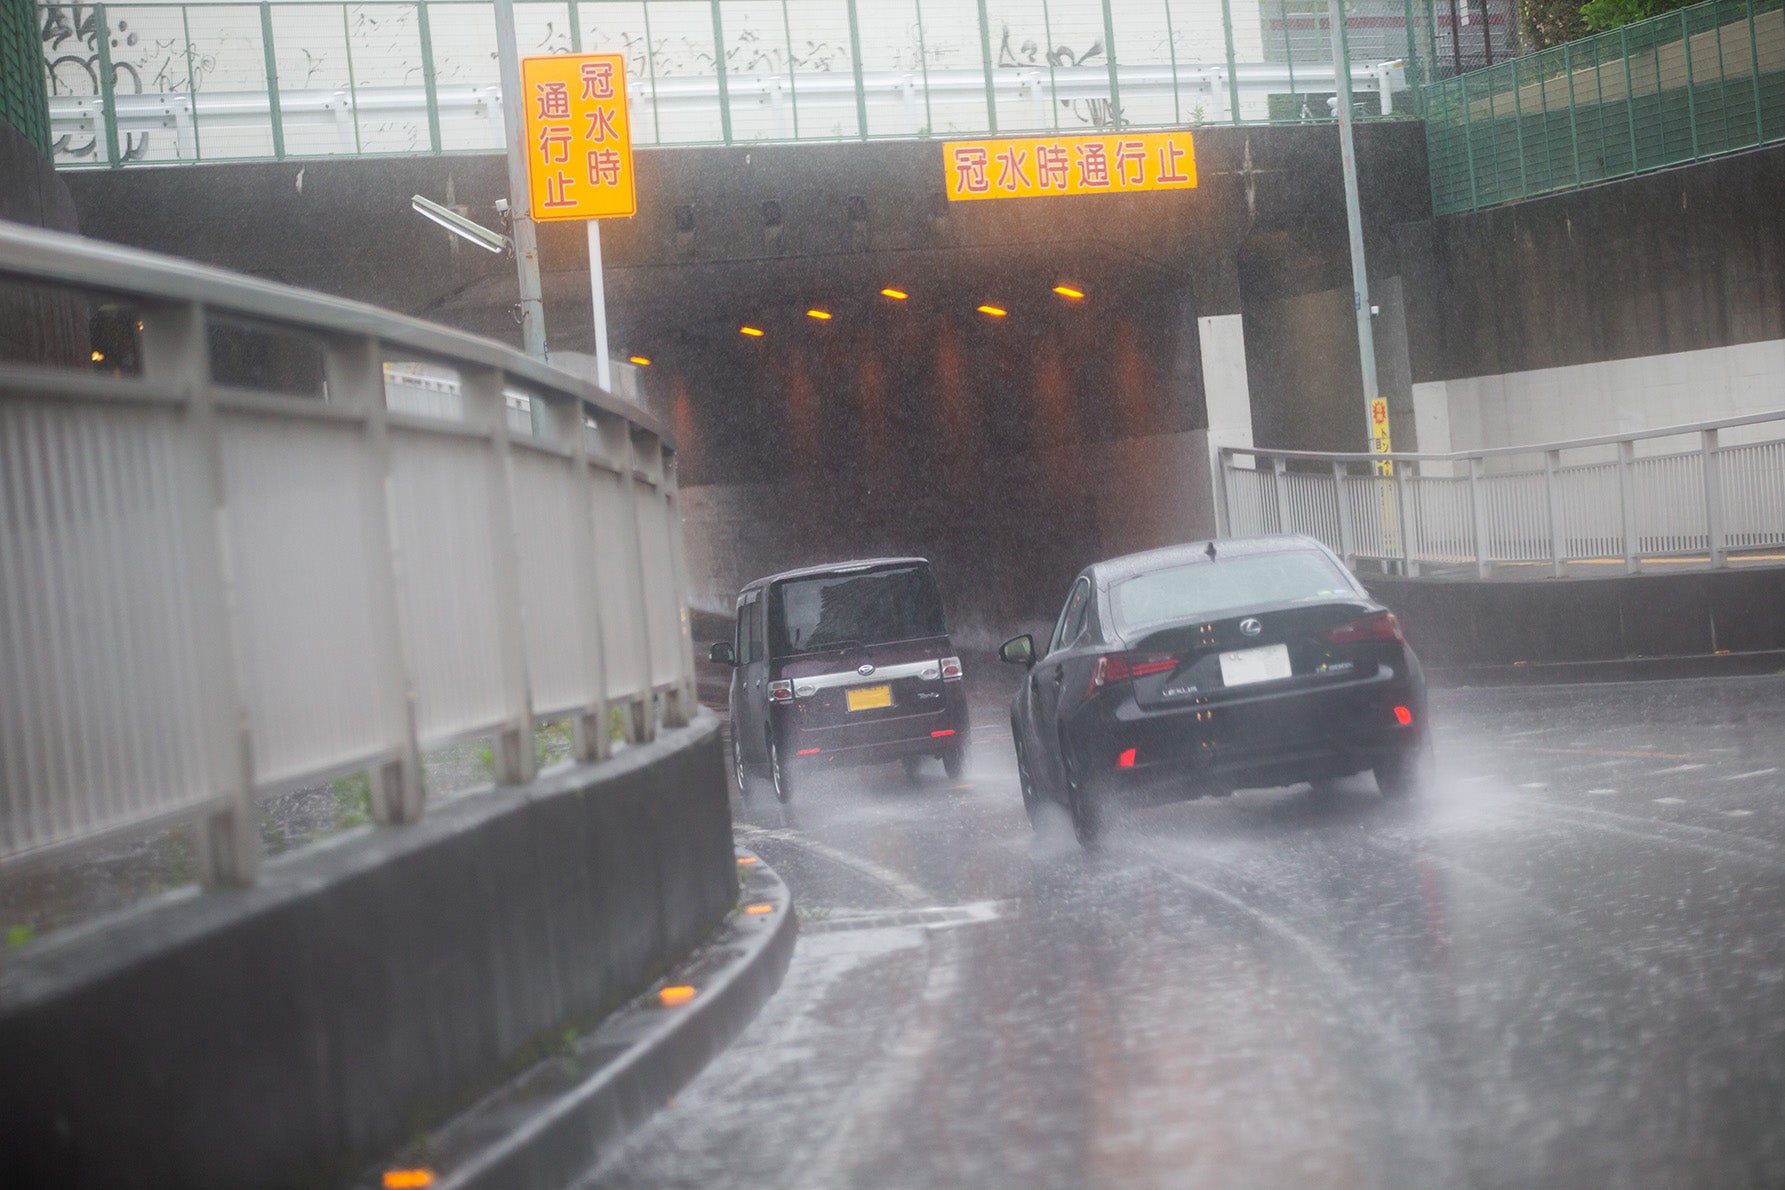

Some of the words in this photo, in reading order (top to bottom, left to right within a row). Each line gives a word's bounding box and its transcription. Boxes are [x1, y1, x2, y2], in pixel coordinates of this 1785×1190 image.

[536, 82, 578, 208] 通行止
[581, 62, 621, 186] 冠水時
[954, 139, 1189, 193] 冠水時通行止
